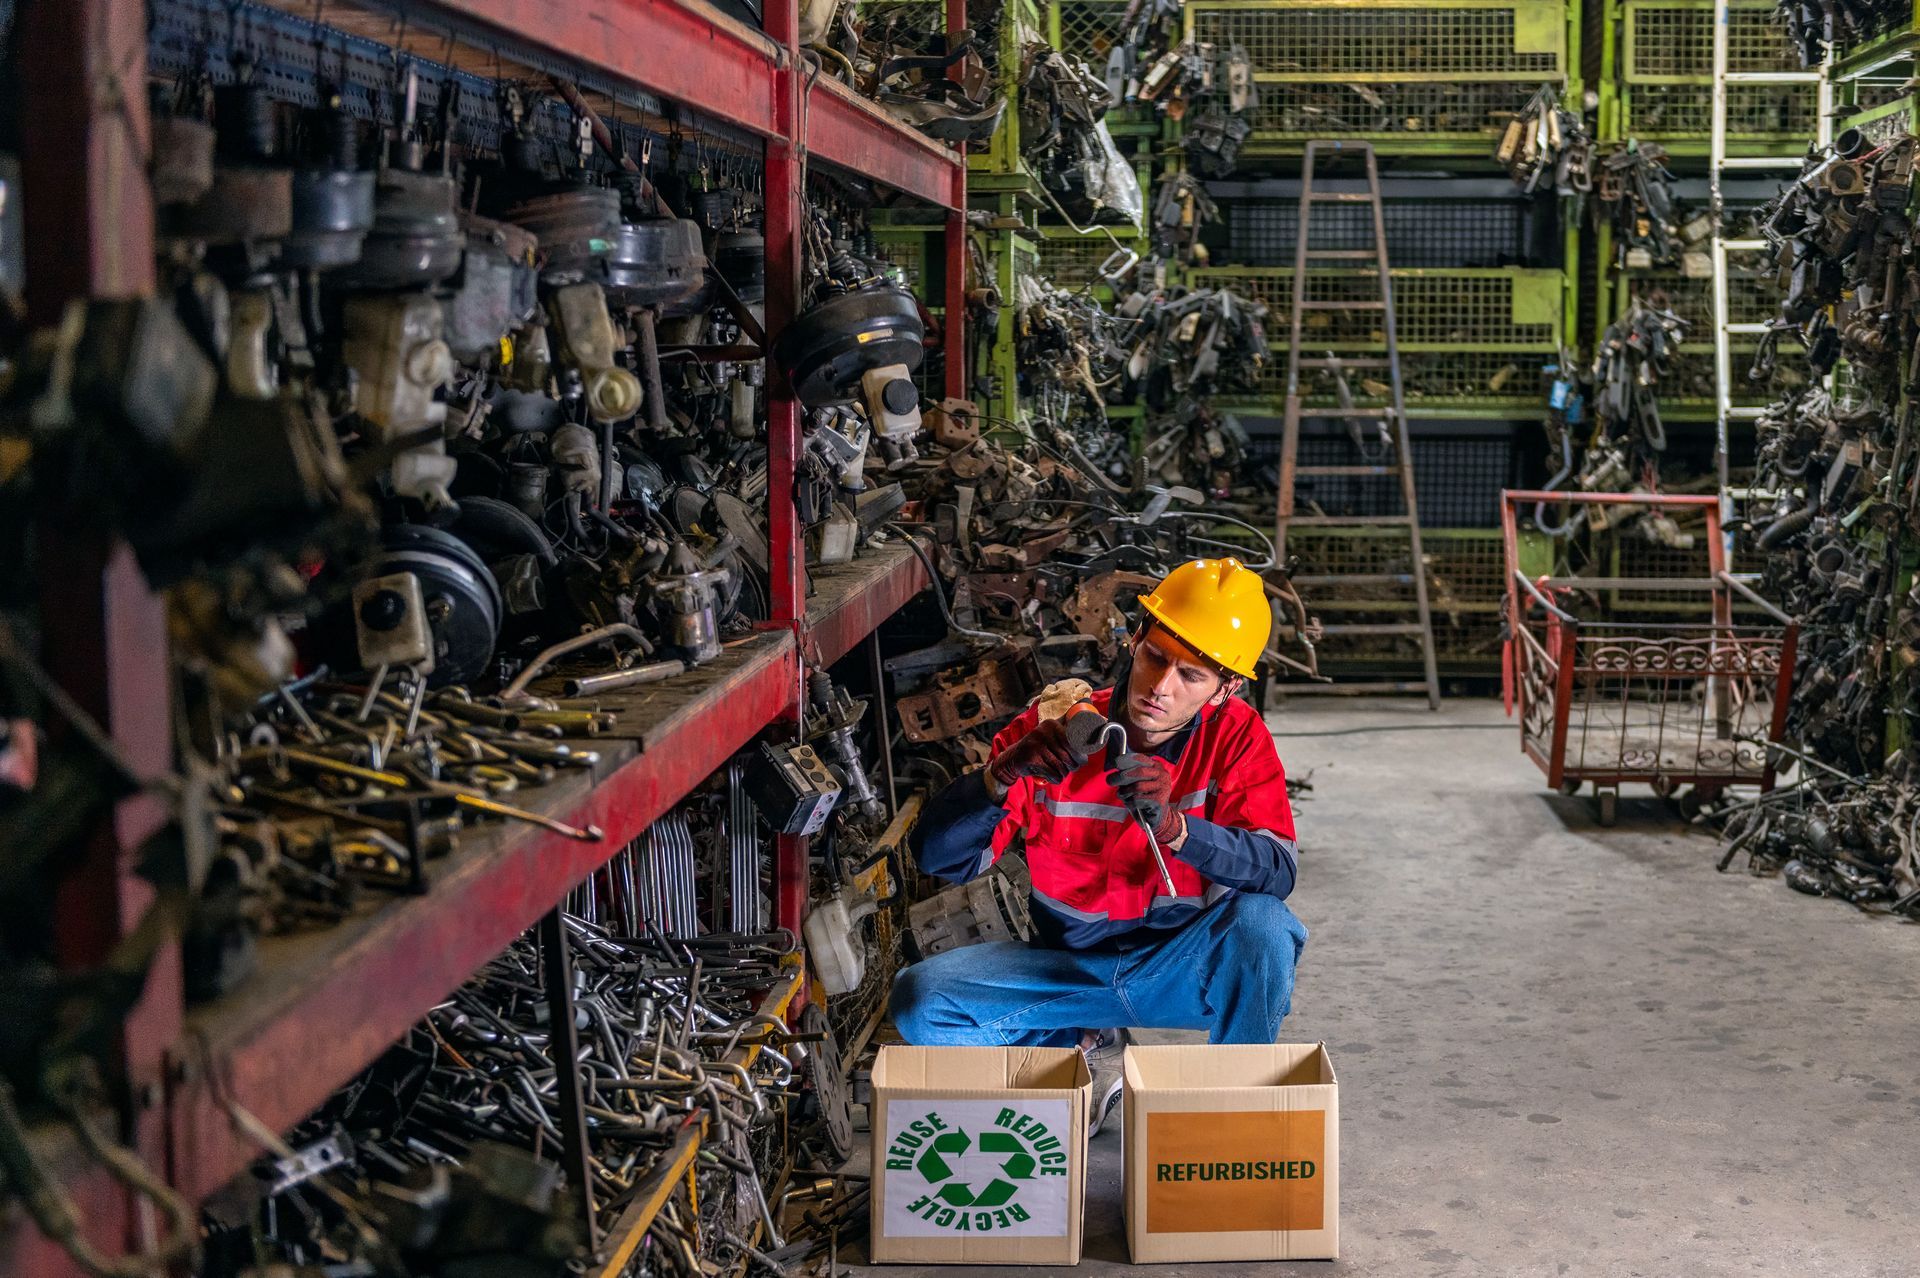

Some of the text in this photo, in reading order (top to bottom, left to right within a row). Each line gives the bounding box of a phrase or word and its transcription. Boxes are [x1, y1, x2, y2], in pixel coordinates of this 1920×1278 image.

[886, 1112, 948, 1171] REUSE
[994, 1107, 1067, 1177] REDUCE
[1157, 1161, 1316, 1182] REFURBISHED
[906, 1195, 1031, 1231] RECYCLE
